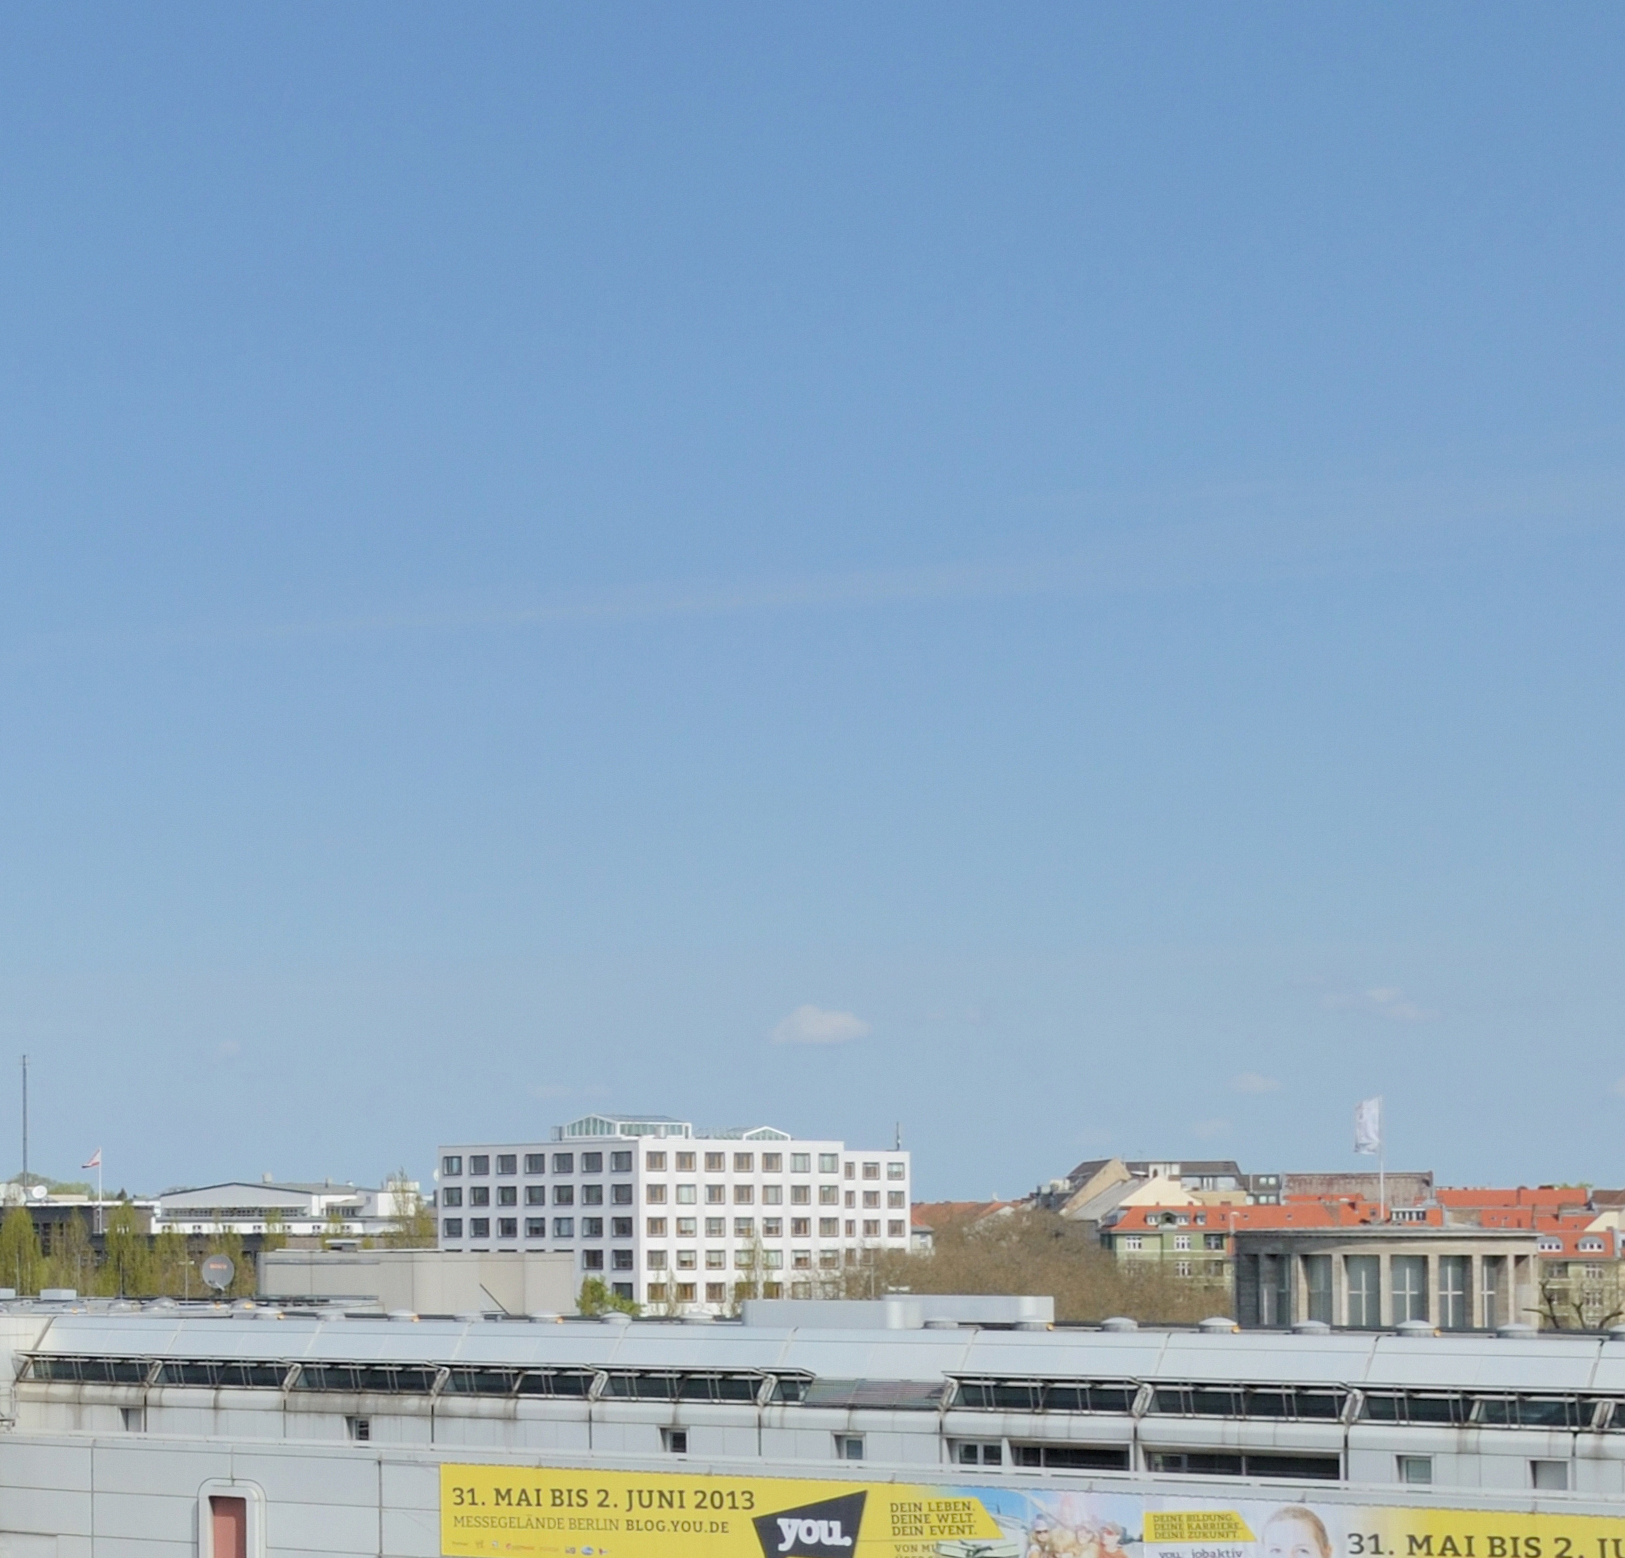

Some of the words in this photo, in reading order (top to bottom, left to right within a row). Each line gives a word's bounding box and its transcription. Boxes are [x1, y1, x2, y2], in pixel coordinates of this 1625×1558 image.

[452, 1487, 486, 1507] 31.
[493, 1488, 543, 1507] MAI
[550, 1489, 589, 1508] BIS
[597, 1489, 618, 1508] 2.
[625, 1489, 685, 1512] JUNI
[693, 1490, 755, 1511] 2013
[890, 1503, 923, 1513] DEIN
[928, 1501, 976, 1512] LEBEN.
[453, 1515, 565, 1530] MESSEGELÄNDE
[568, 1518, 619, 1531] BERLIN
[625, 1519, 729, 1534] BLOG.YOU.DE
[891, 1513, 931, 1525] DEINE
[936, 1513, 977, 1523] WELT.
[1153, 1515, 1183, 1523] DEINE
[892, 1525, 924, 1536] DEIN
[930, 1525, 977, 1535] EVENT.
[1153, 1523, 1183, 1531] DEINE
[1187, 1522, 1243, 1530] KARRIERE.
[777, 1518, 852, 1551] you.
[1154, 1531, 1185, 1539] DEINE
[1187, 1531, 1239, 1539] ZUKUNFT.
[894, 1544, 919, 1553] VON
[1347, 1533, 1394, 1555] 31.
[1406, 1534, 1475, 1557] MAI
[1487, 1535, 1542, 1558] BIS
